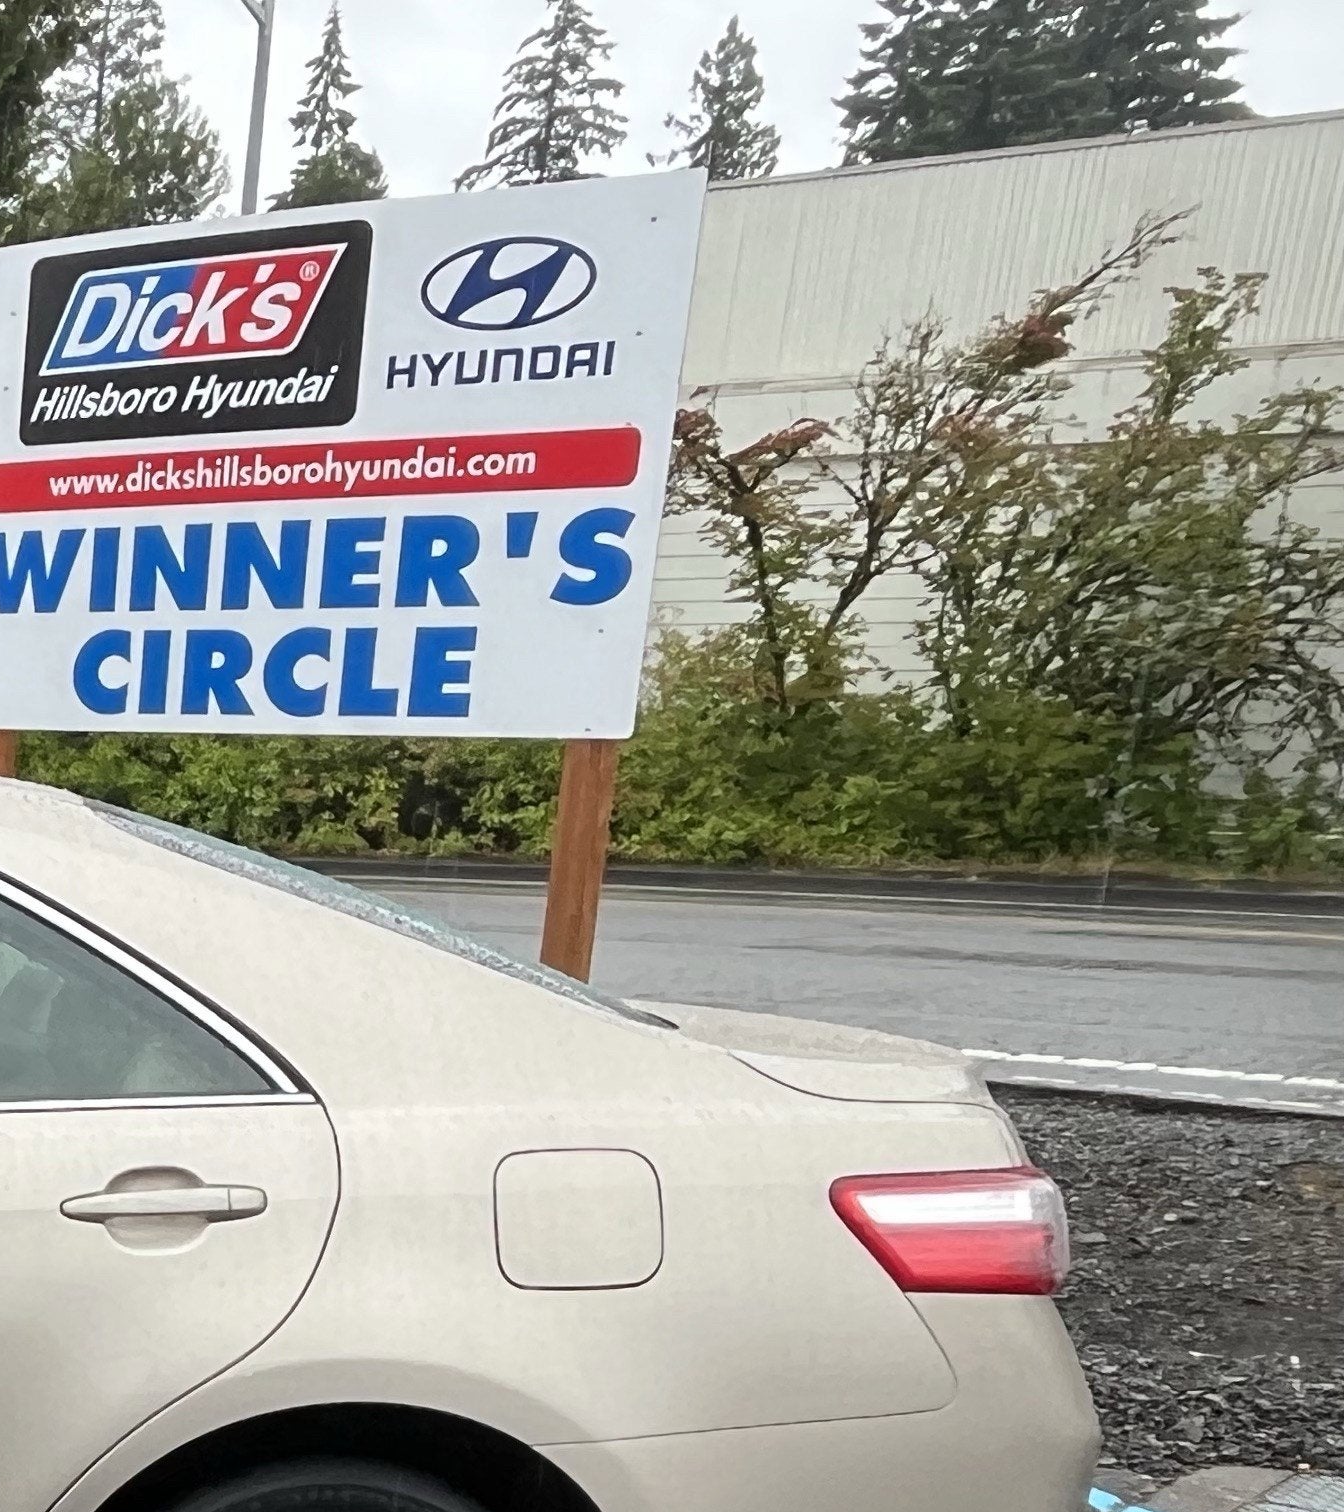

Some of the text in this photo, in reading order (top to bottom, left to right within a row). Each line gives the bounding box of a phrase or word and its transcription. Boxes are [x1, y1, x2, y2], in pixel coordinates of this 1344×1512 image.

[386, 340, 616, 389] HYUNDAI
[30, 365, 339, 424] Hillsboro Hyundai
[49, 445, 537, 498] www.dickshillsborohyundai.com
[73, 625, 478, 718] CIRCLE
